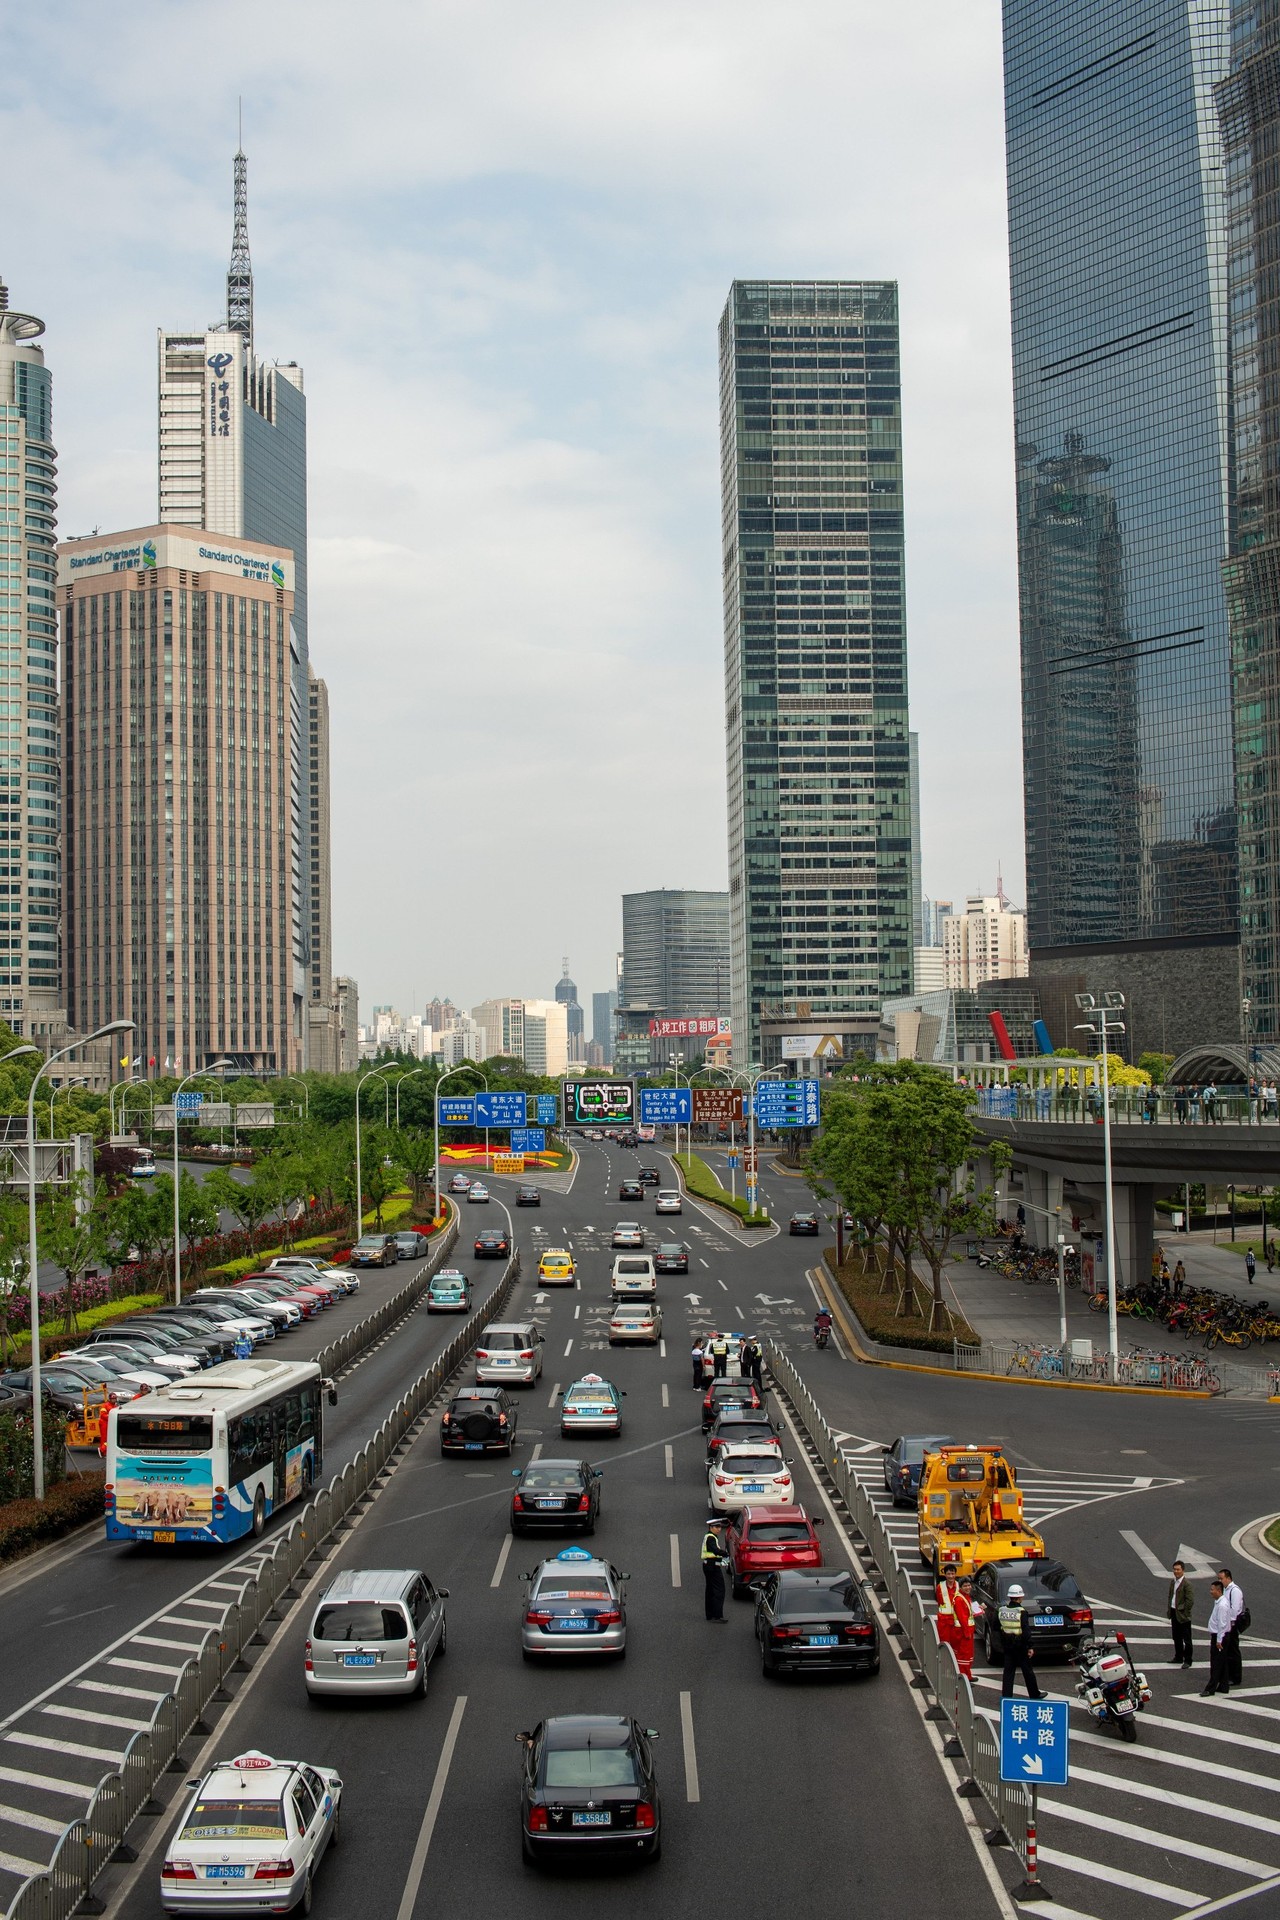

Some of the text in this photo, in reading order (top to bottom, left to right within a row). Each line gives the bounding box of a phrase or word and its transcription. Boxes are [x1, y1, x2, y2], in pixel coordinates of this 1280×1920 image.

[218, 381, 230, 436] 中国电信
[70, 546, 140, 568] Standard Chartered
[113, 559, 140, 571] 渣打银行
[199, 547, 269, 570] Standard Chartered
[242, 568, 269, 581] 渣打银行
[662, 1021, 687, 1033] 找工作
[644, 1092, 677, 1100] 世纪大道
[806, 1081, 817, 1114] 东泰路
[1011, 1704, 1054, 1725] 银城
[1011, 1727, 1055, 1747] 中路
